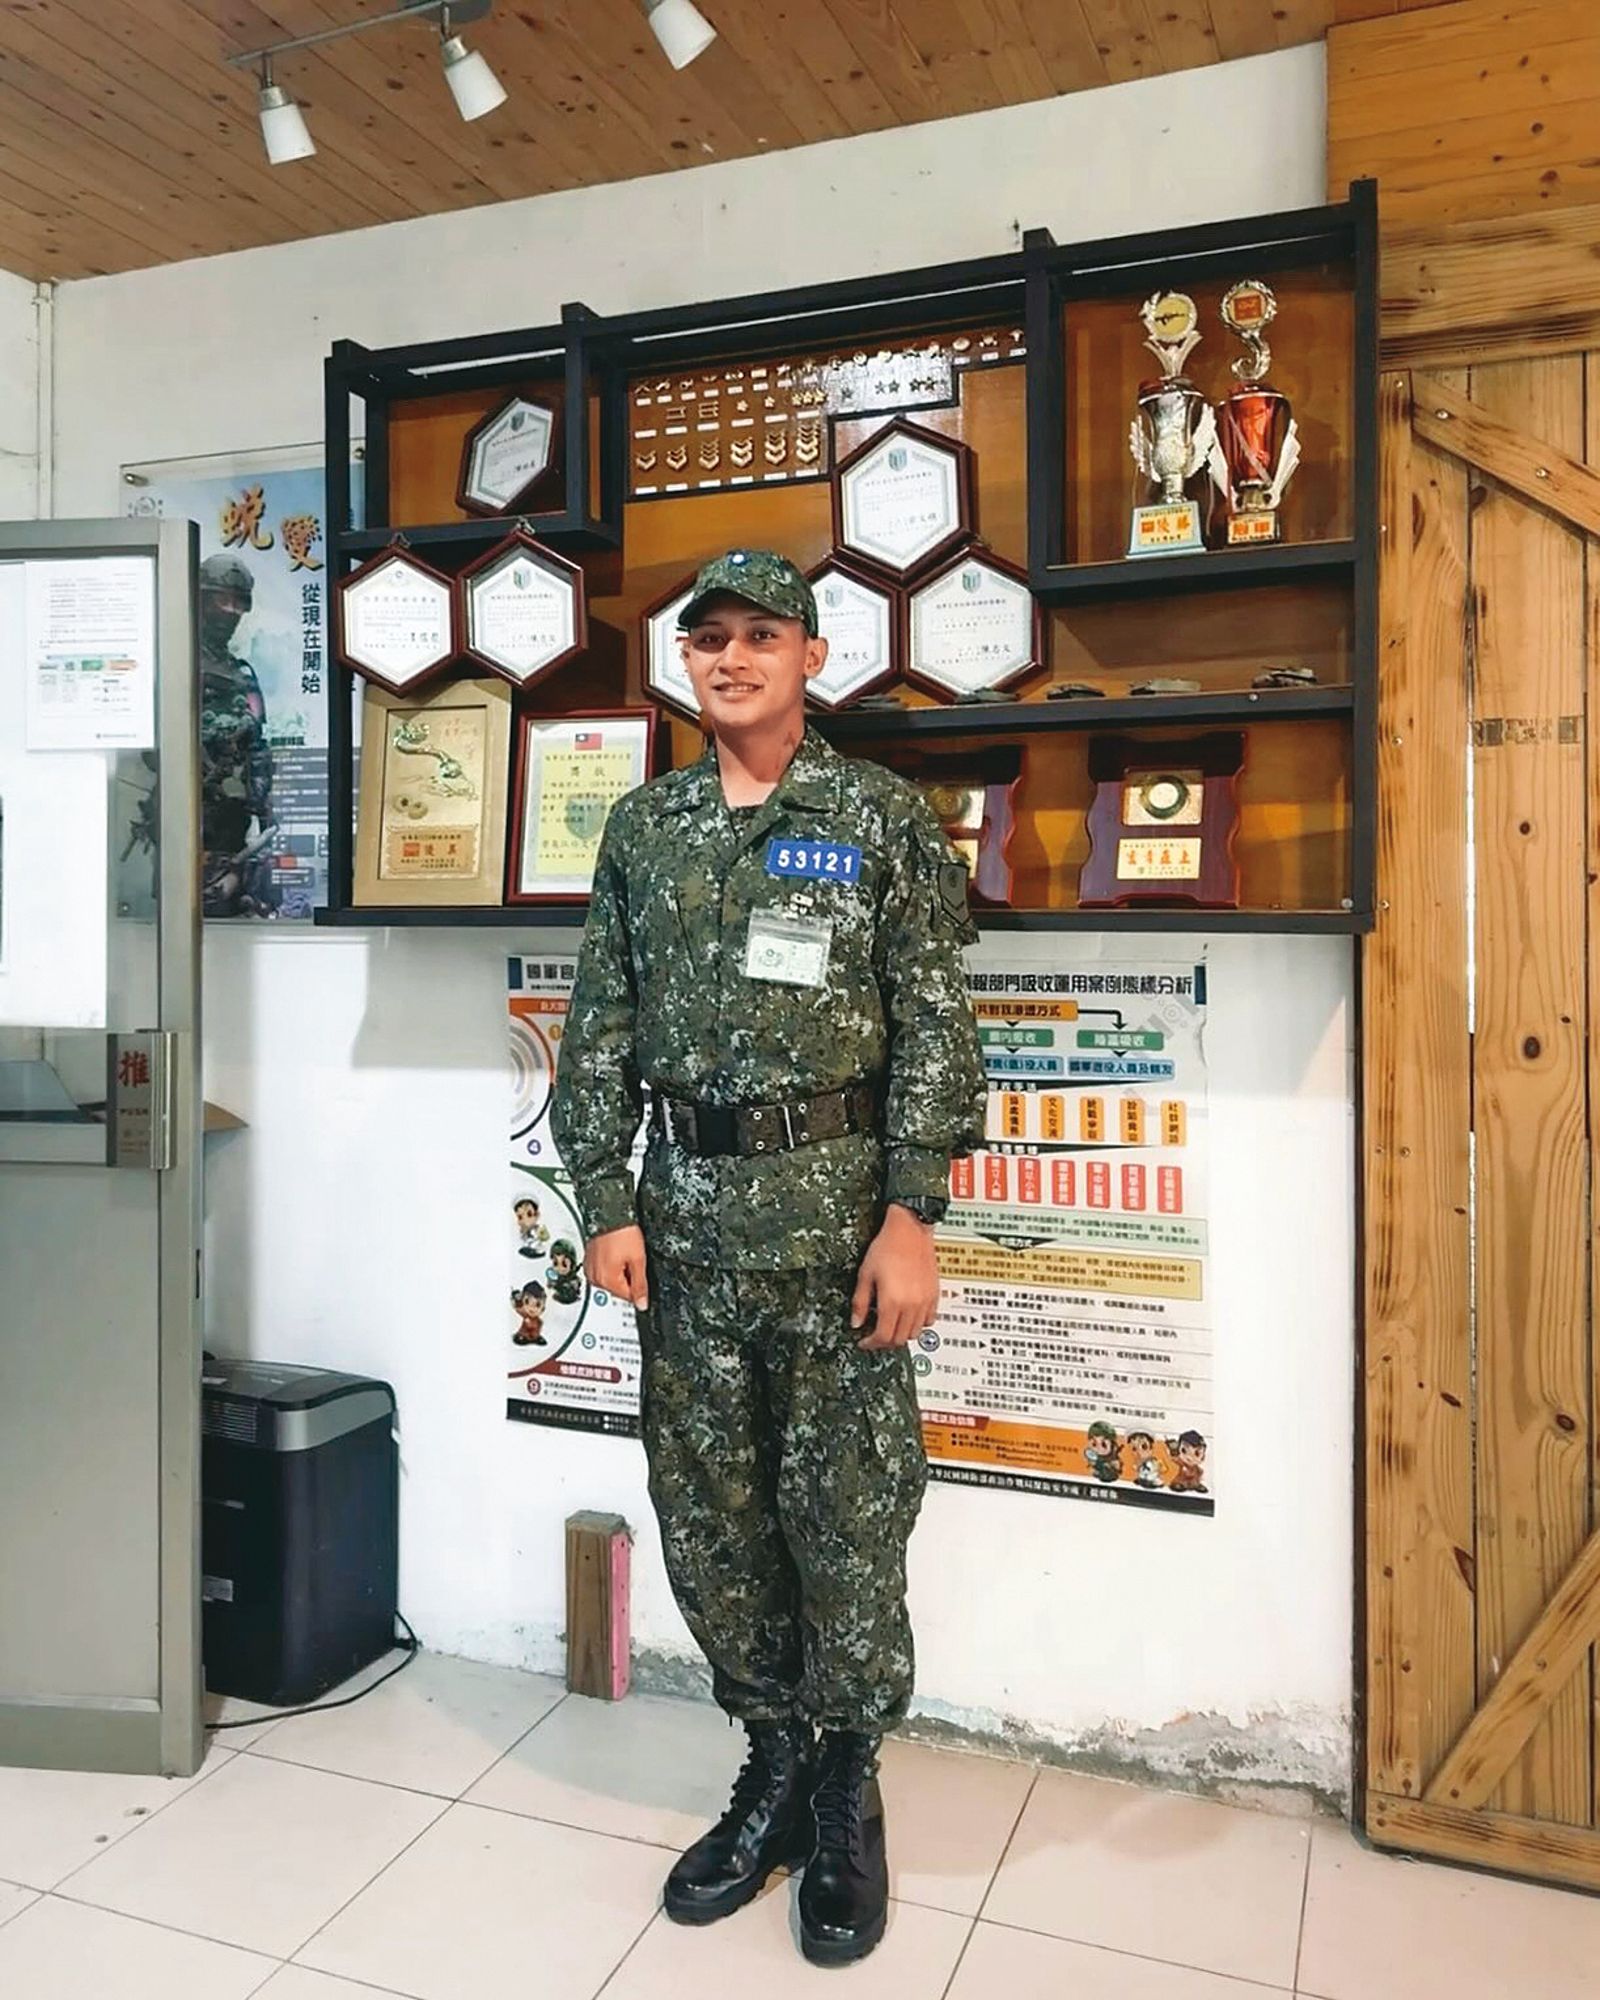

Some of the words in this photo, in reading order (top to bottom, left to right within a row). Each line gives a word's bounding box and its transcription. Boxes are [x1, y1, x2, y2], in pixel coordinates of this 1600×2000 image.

[218, 484, 325, 573] 蛻變
[302, 582, 322, 694] 從現在開始
[778, 849, 852, 874] 53121
[118, 1050, 150, 1088] 推
